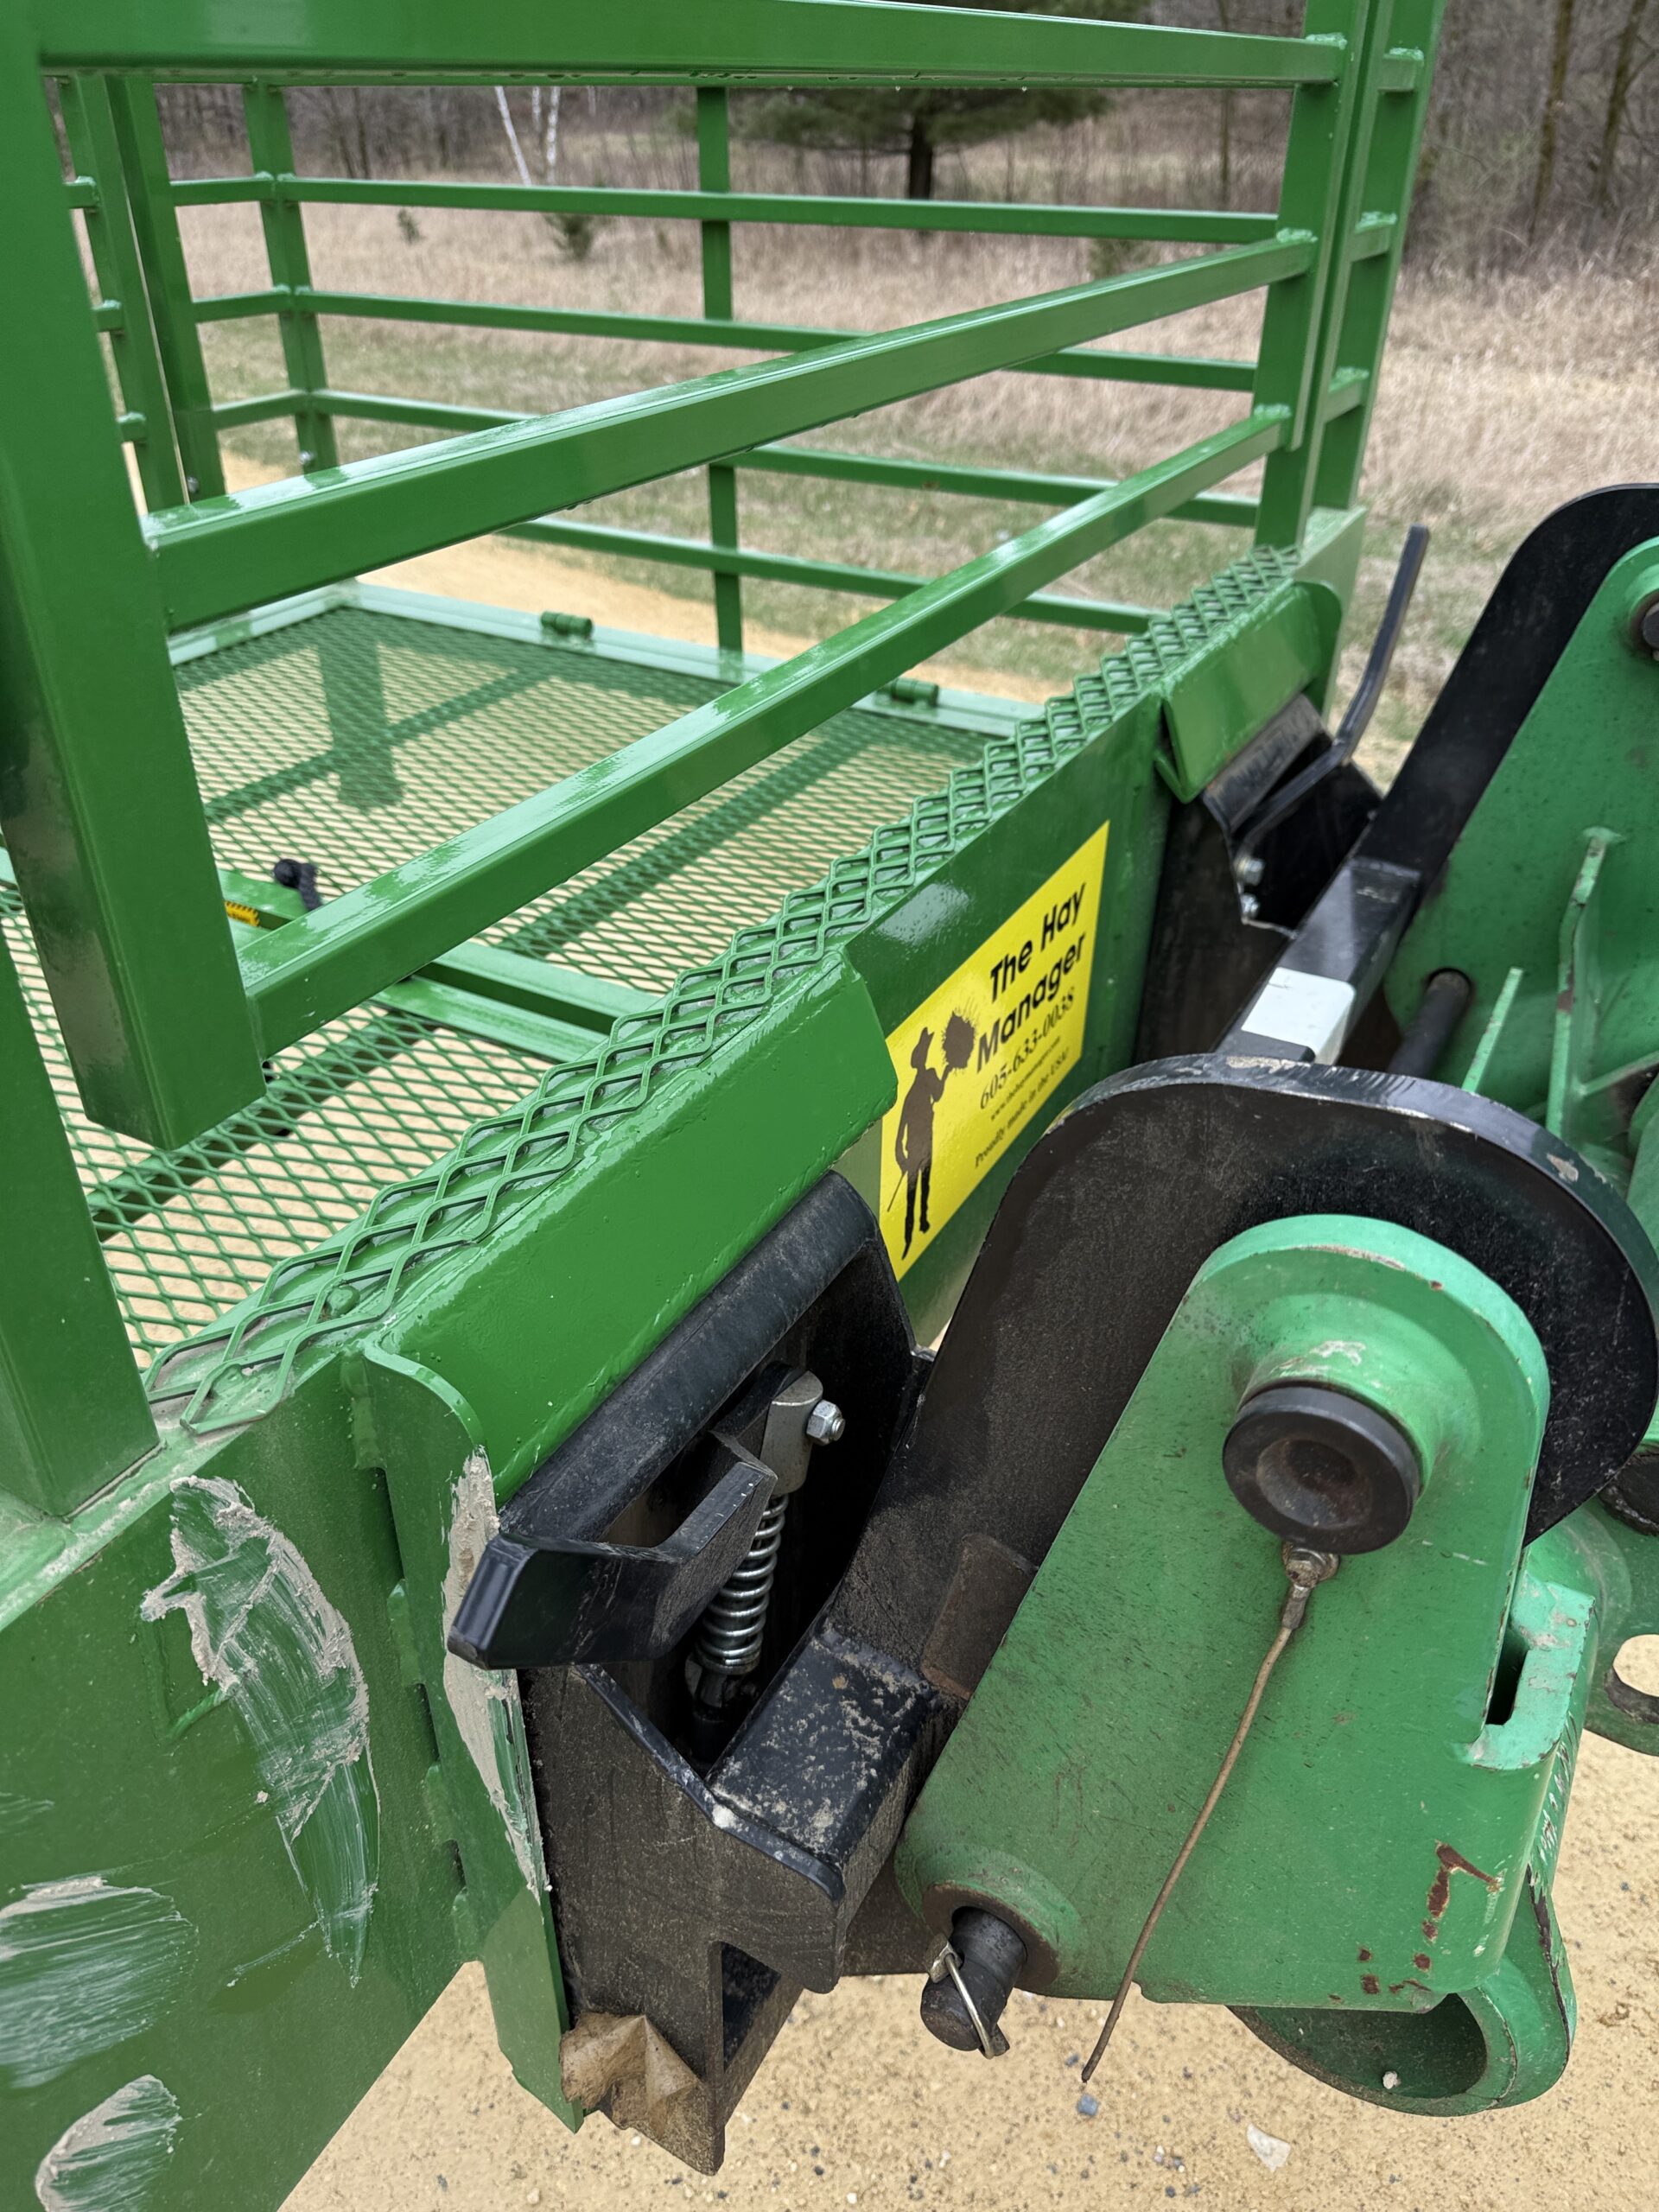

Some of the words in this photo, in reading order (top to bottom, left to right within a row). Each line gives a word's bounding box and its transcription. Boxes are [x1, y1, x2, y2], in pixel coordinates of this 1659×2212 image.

[977, 931, 1086, 1074] Manager
[990, 940, 1033, 1003] The
[1041, 881, 1086, 952] Hay
[981, 986, 1075, 1109] 605-633-0038
[975, 1128, 1005, 1168] Proudly
[1007, 1101, 1027, 1128] made
[1029, 1089, 1036, 1103] in
[1038, 1074, 1049, 1092] the
